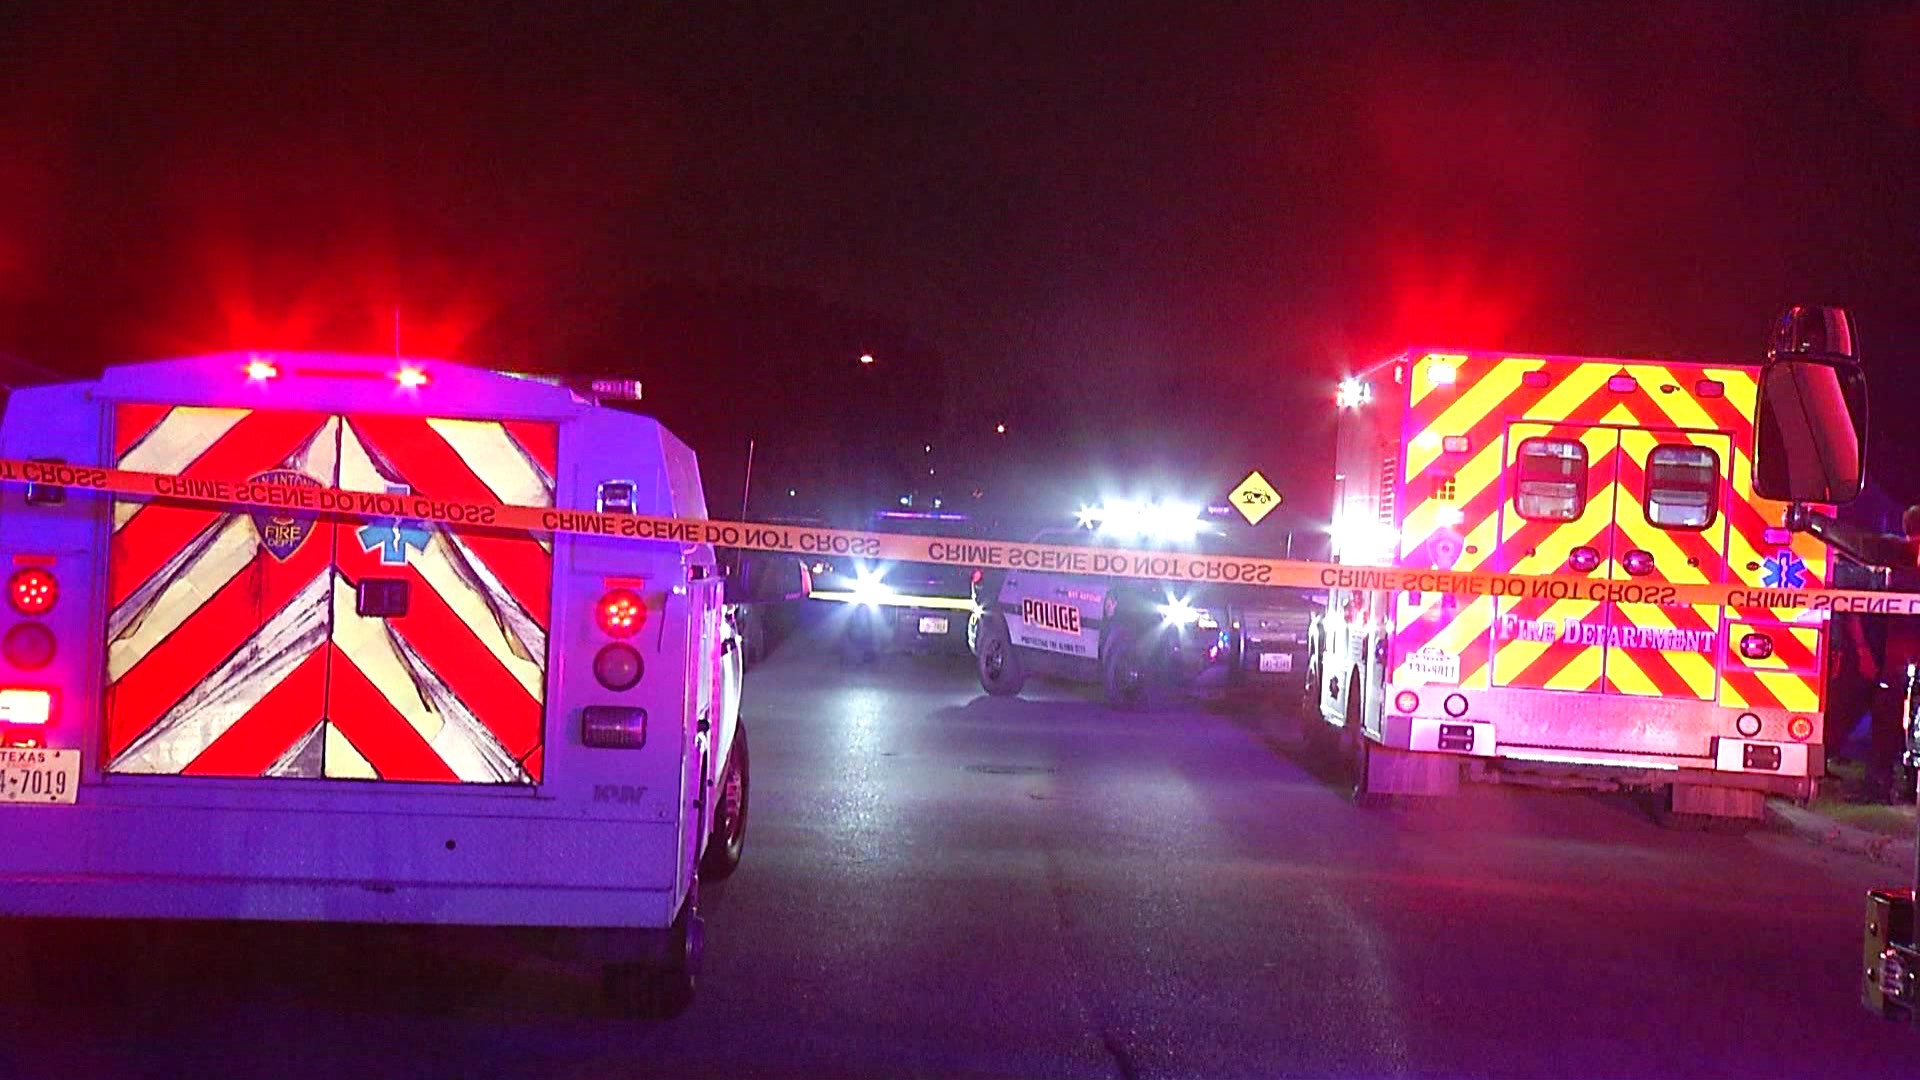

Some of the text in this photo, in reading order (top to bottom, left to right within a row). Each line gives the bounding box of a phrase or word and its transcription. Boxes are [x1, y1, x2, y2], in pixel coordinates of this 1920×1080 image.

[265, 526, 301, 540] FIRE
[1023, 598, 1080, 634] POLICE
[1499, 613, 1716, 653] FIRE DEPARTMENT
[0, 751, 46, 763] TEXAS
